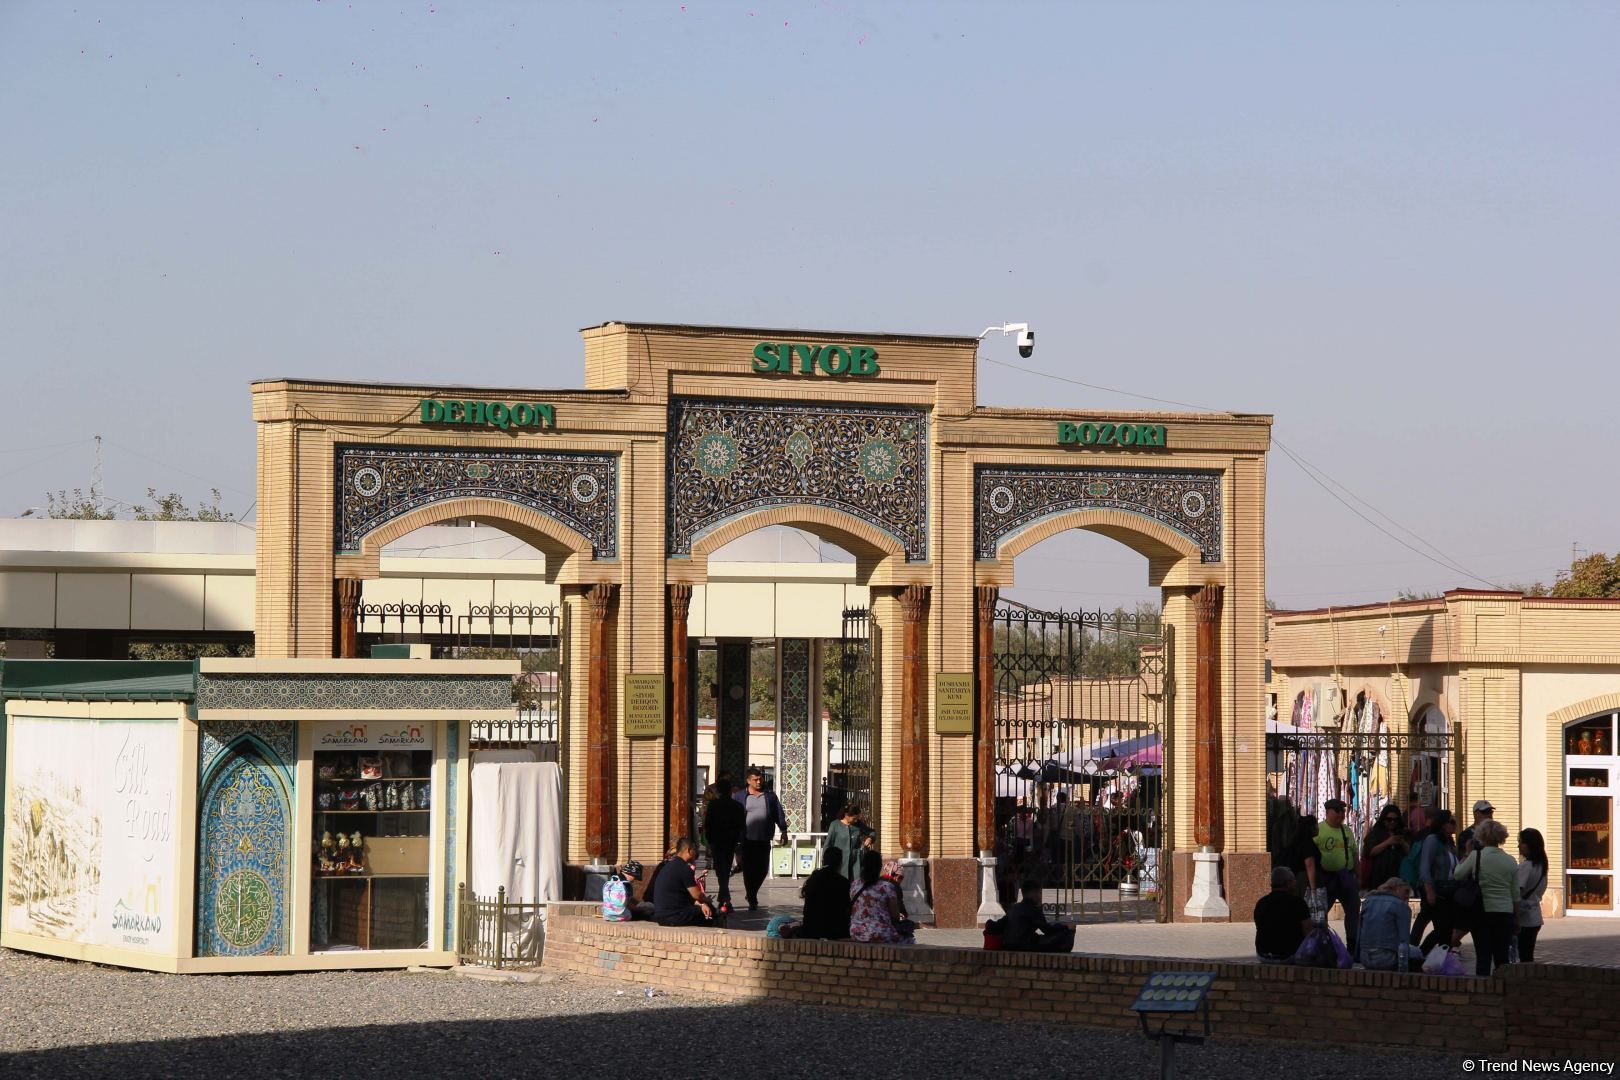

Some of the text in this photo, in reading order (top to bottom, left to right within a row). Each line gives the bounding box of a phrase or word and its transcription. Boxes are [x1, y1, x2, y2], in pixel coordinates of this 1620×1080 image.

[752, 341, 879, 375] SIYOB
[420, 399, 554, 429] DEHQON
[1057, 421, 1166, 446] BOZORI
[321, 736, 368, 744] SAMARKAND
[378, 736, 425, 744] SAMARKAND
[112, 910, 162, 934] SAMARKAND
